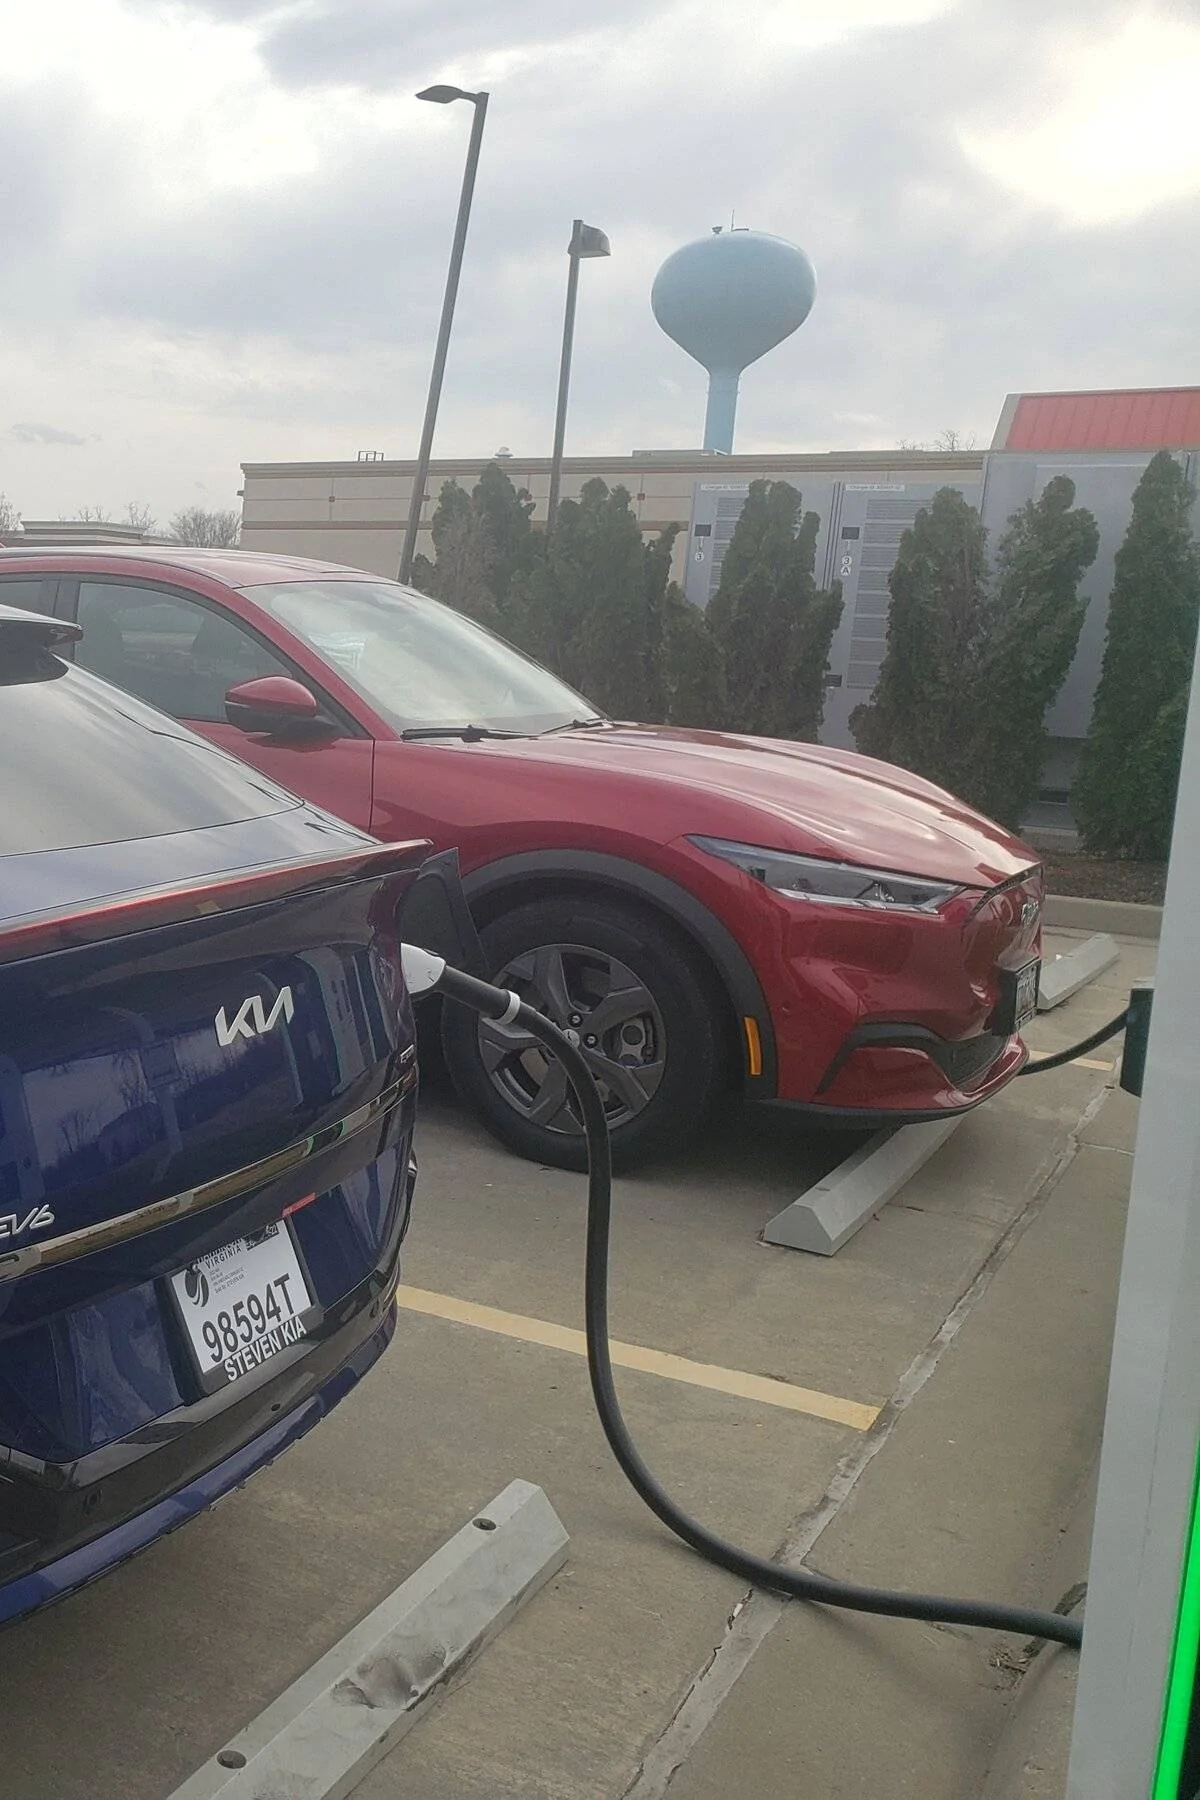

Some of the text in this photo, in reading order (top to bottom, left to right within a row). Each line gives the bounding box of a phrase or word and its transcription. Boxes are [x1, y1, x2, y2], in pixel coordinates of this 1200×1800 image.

[214, 986, 294, 1047] KIA
[205, 1244, 242, 1269] VIRGINIA
[202, 1273, 294, 1362] 98594T
[224, 1315, 307, 1381] STEVEN KIA
